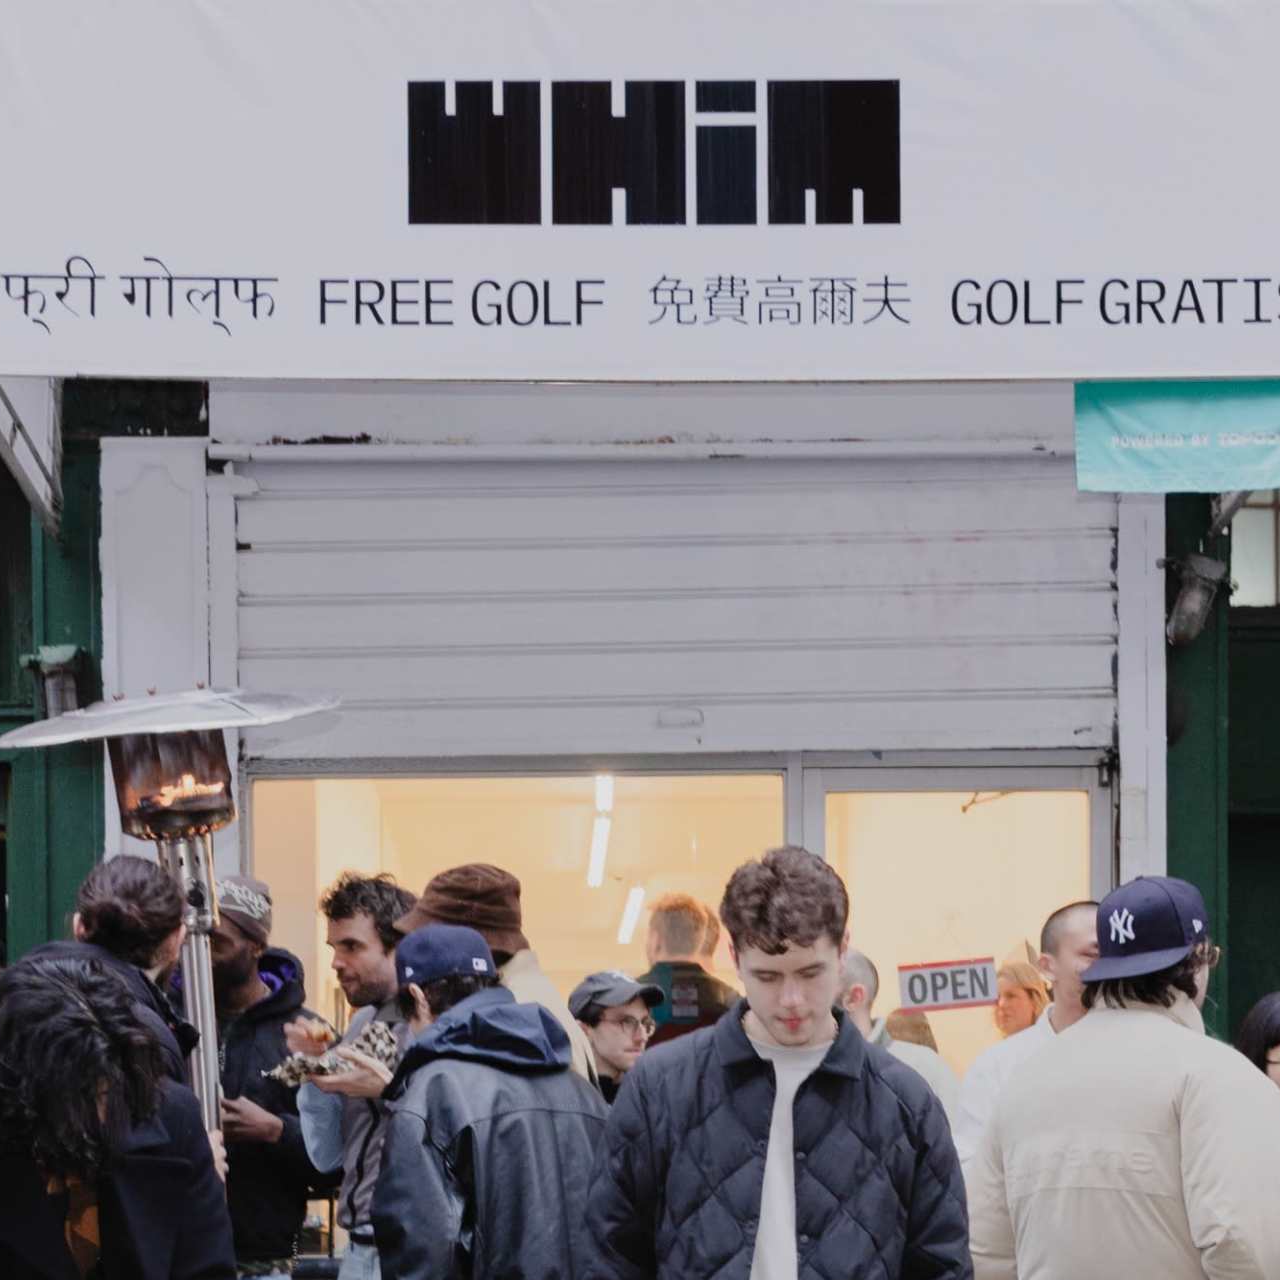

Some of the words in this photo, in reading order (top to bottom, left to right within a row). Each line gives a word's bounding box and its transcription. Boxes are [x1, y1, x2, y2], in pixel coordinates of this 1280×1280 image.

[319, 279, 455, 326] FREE
[471, 278, 606, 327] GOLF
[648, 273, 912, 326] 免費高爾夫
[951, 278, 1086, 326] GOLF
[907, 966, 990, 1005] OPEN
